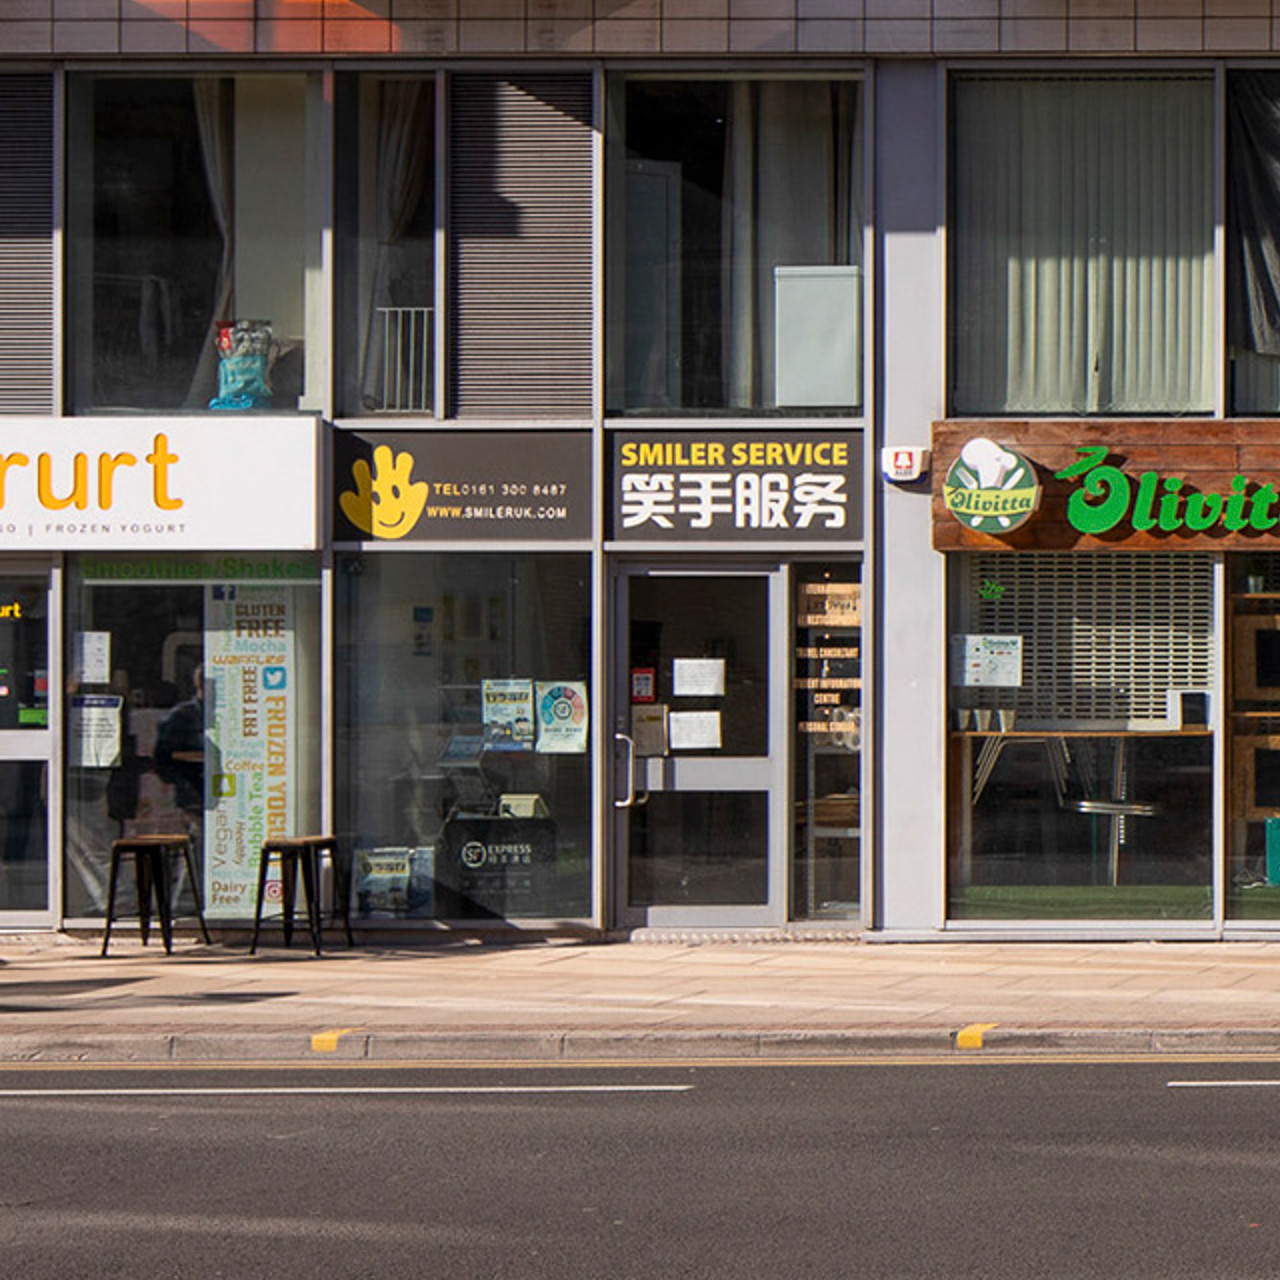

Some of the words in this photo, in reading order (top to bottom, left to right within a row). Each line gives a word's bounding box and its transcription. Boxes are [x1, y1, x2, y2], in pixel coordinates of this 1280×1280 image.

[621, 442, 725, 466] SMILER
[732, 442, 848, 466] SERVICE
[501, 484, 528, 496] 300
[532, 484, 567, 496] 8487
[621, 473, 848, 528] 笑手服务
[949, 488, 1032, 511] Olivitta
[426, 506, 567, 519] WWW.SMILERUK.COM
[45, 524, 111, 533] FROZEN
[121, 524, 185, 533] YOGURT
[235, 604, 286, 617] GLUTEN
[235, 619, 286, 638] FREE
[235, 640, 286, 653] Mocha
[242, 666, 259, 703] FREE
[266, 696, 287, 777] FROZEN
[225, 760, 264, 772] Coffee
[248, 771, 264, 801] Tea
[213, 798, 232, 869] Vegan
[248, 805, 264, 868] Bubble
[488, 844, 532, 853] EXPRESS
[212, 881, 247, 895] Dairy
[212, 894, 240, 905] Free
